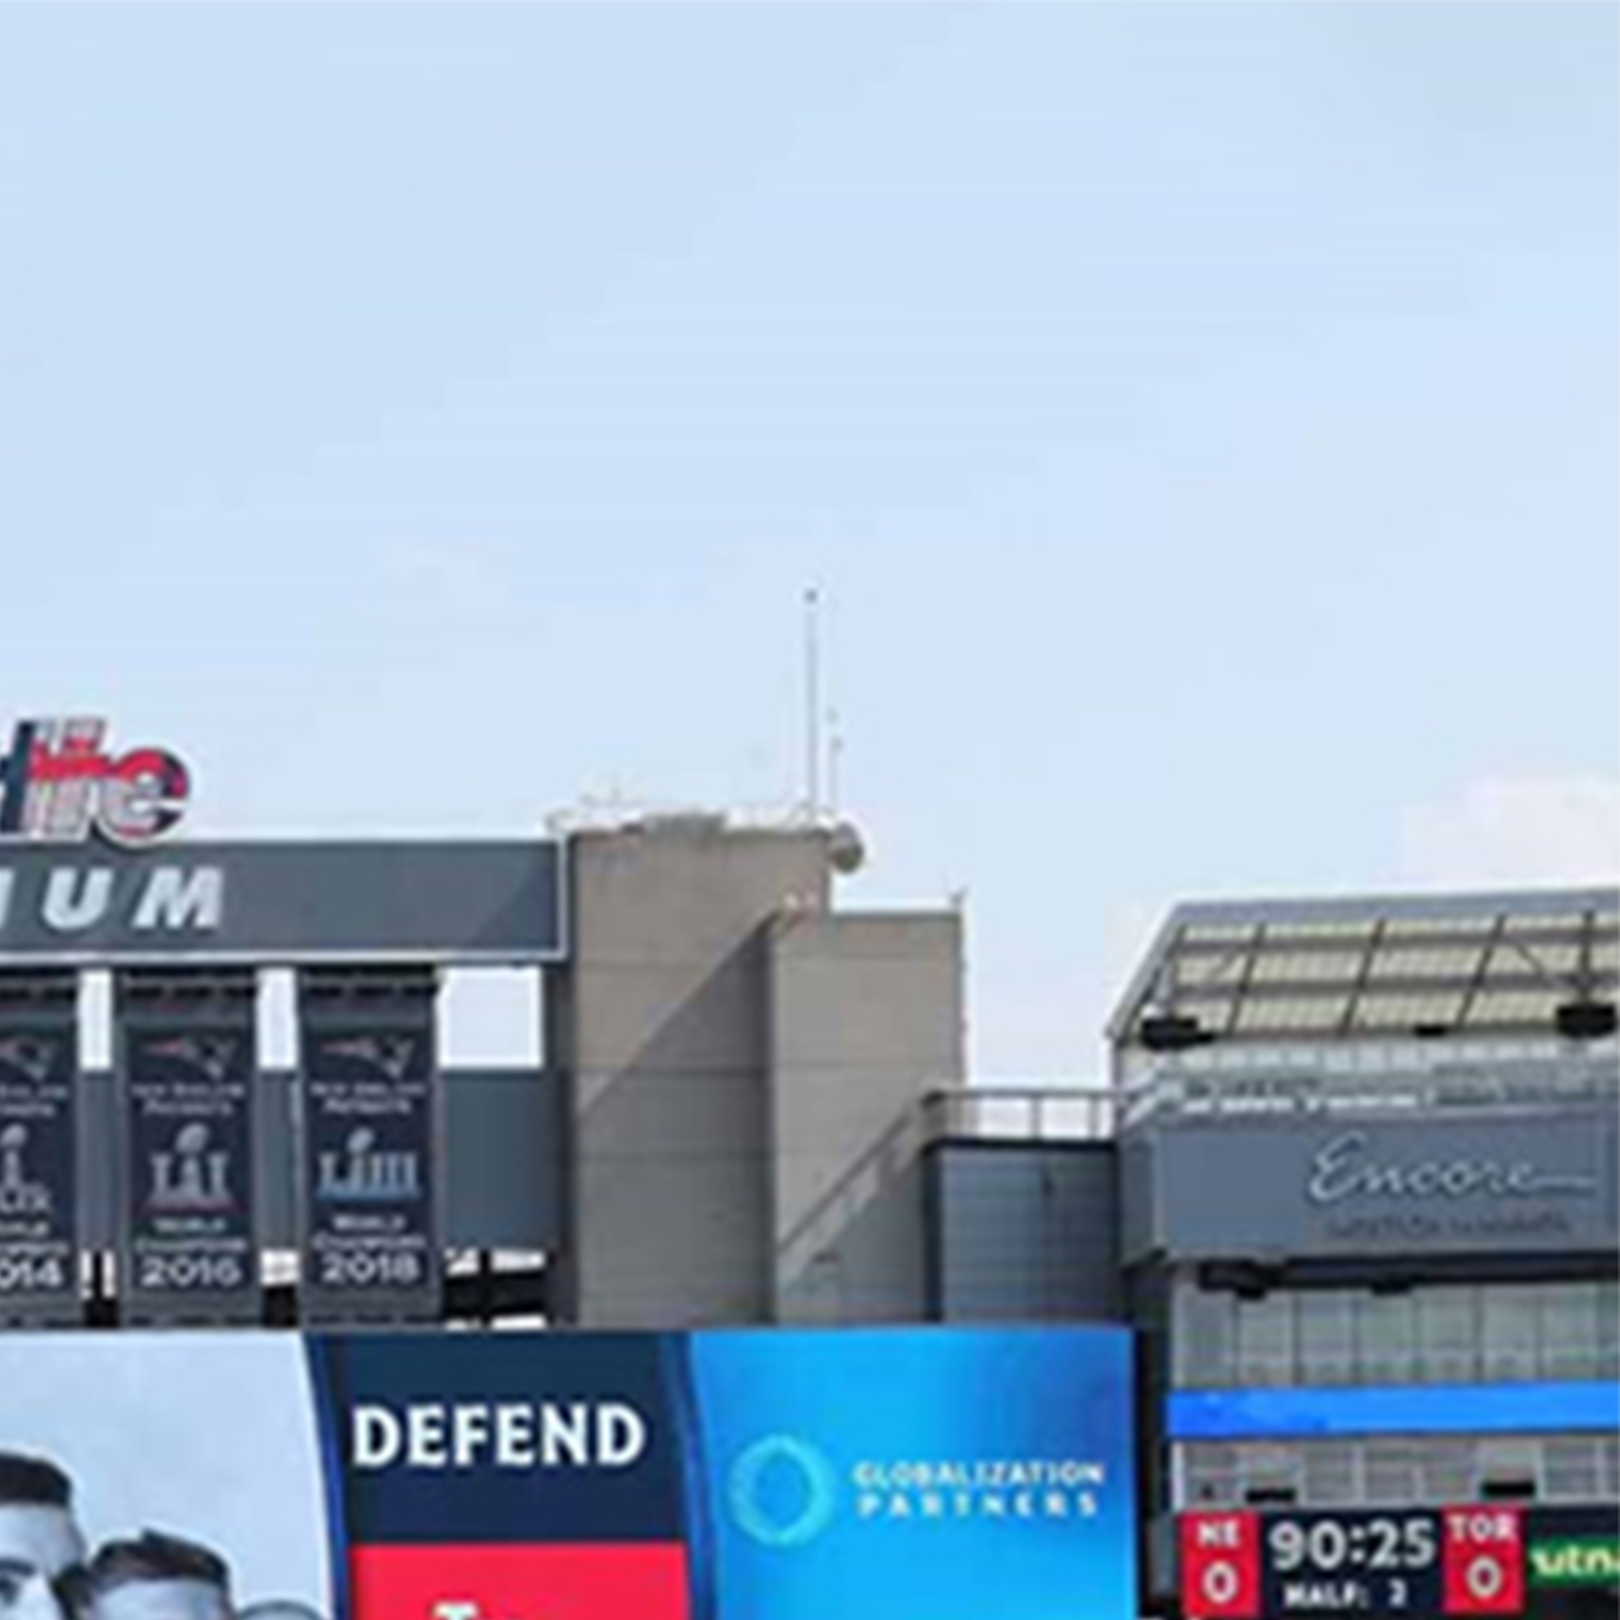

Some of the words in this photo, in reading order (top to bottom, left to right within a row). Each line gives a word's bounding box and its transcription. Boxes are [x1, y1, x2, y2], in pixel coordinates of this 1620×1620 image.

[1308, 1130, 1595, 1201] Encore
[353, 1405, 646, 1468] DEFEND
[851, 1459, 1106, 1489] GLOBALIZATION
[857, 1492, 1099, 1518] PARTNERS
[1198, 1521, 1240, 1547] NE
[1268, 1518, 1437, 1571] 90:25
[1448, 1514, 1518, 1542] TOR
[1202, 1560, 1239, 1604] 0
[1284, 1583, 1369, 1608] HALF:
[1389, 1579, 1409, 1607] 2
[1466, 1556, 1503, 1599] 0
